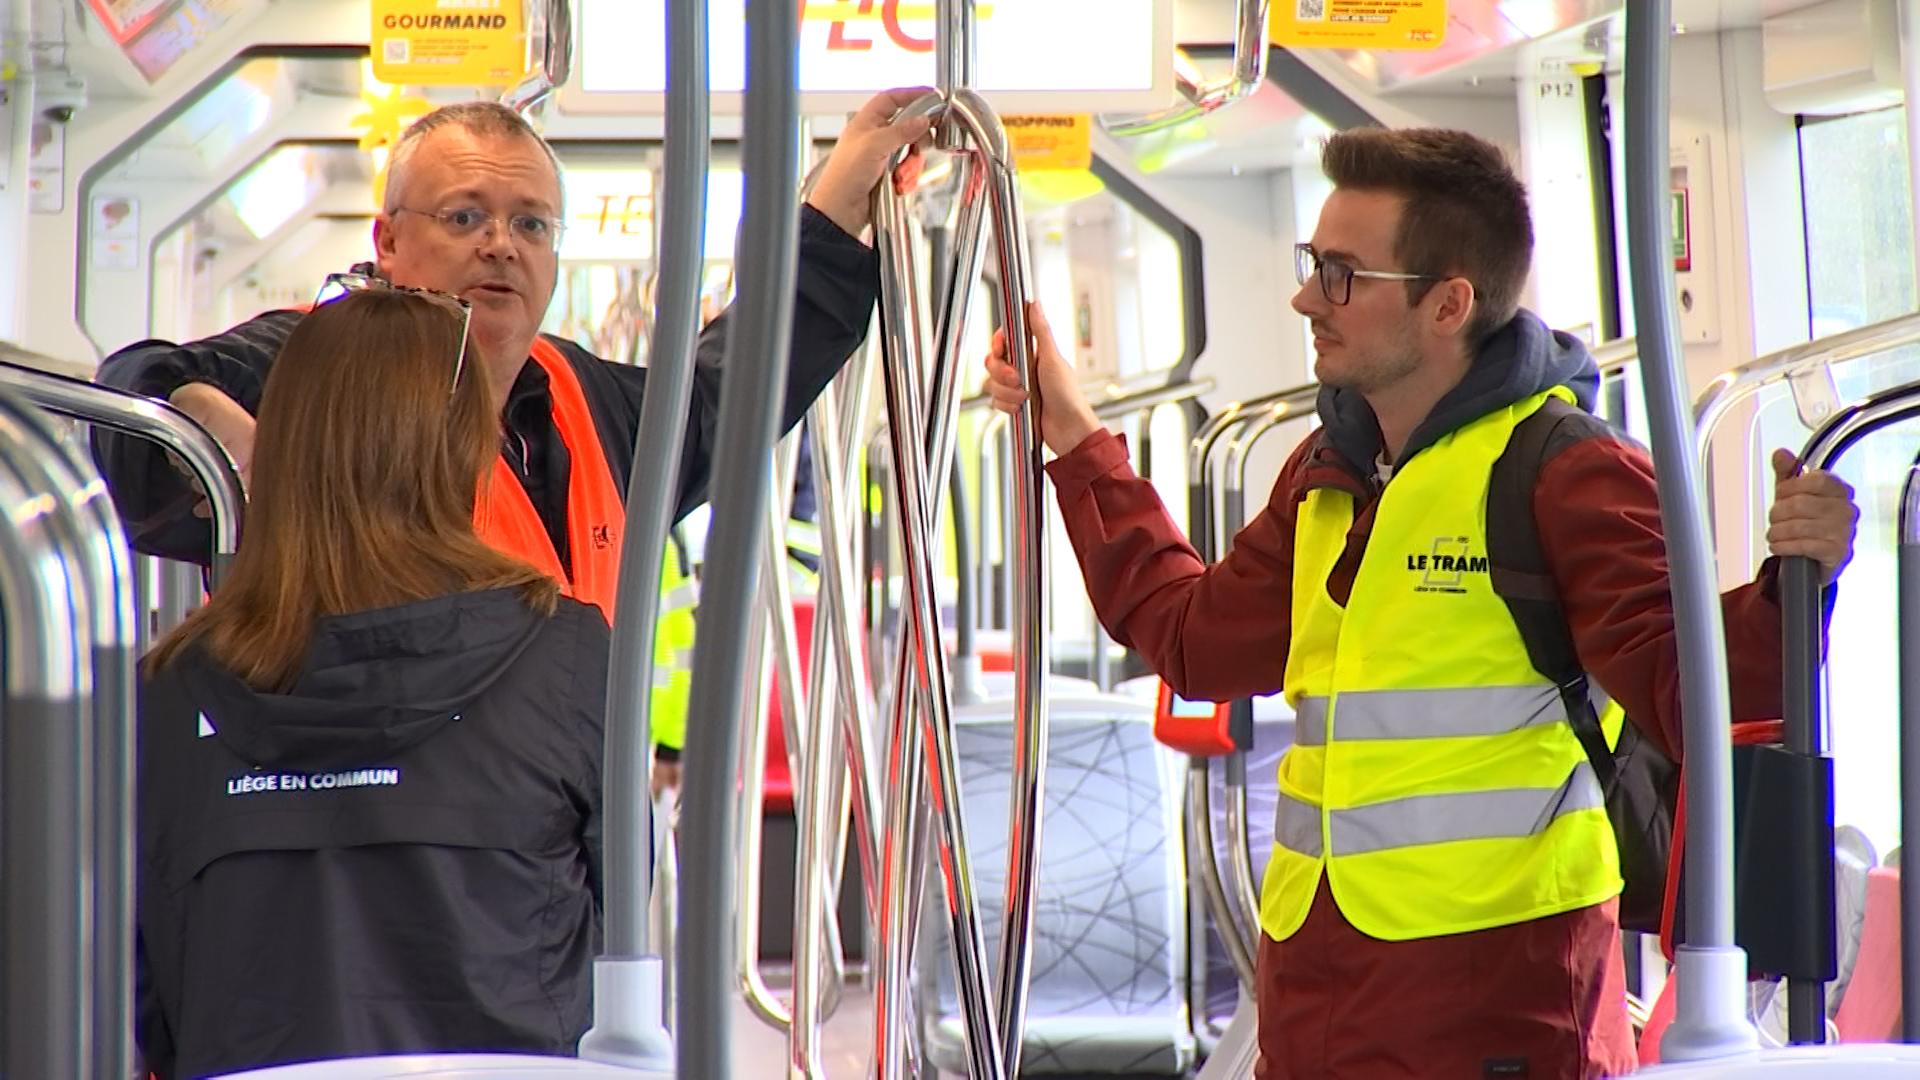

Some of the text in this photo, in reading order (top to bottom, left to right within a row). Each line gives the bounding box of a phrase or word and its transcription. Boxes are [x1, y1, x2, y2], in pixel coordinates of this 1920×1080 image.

[384, 15, 507, 29] GOURMAND
[597, 195, 654, 234] TE
[1407, 555, 1487, 572] LE TRAM
[227, 769, 399, 794] LIÈGE EN COMMUN
